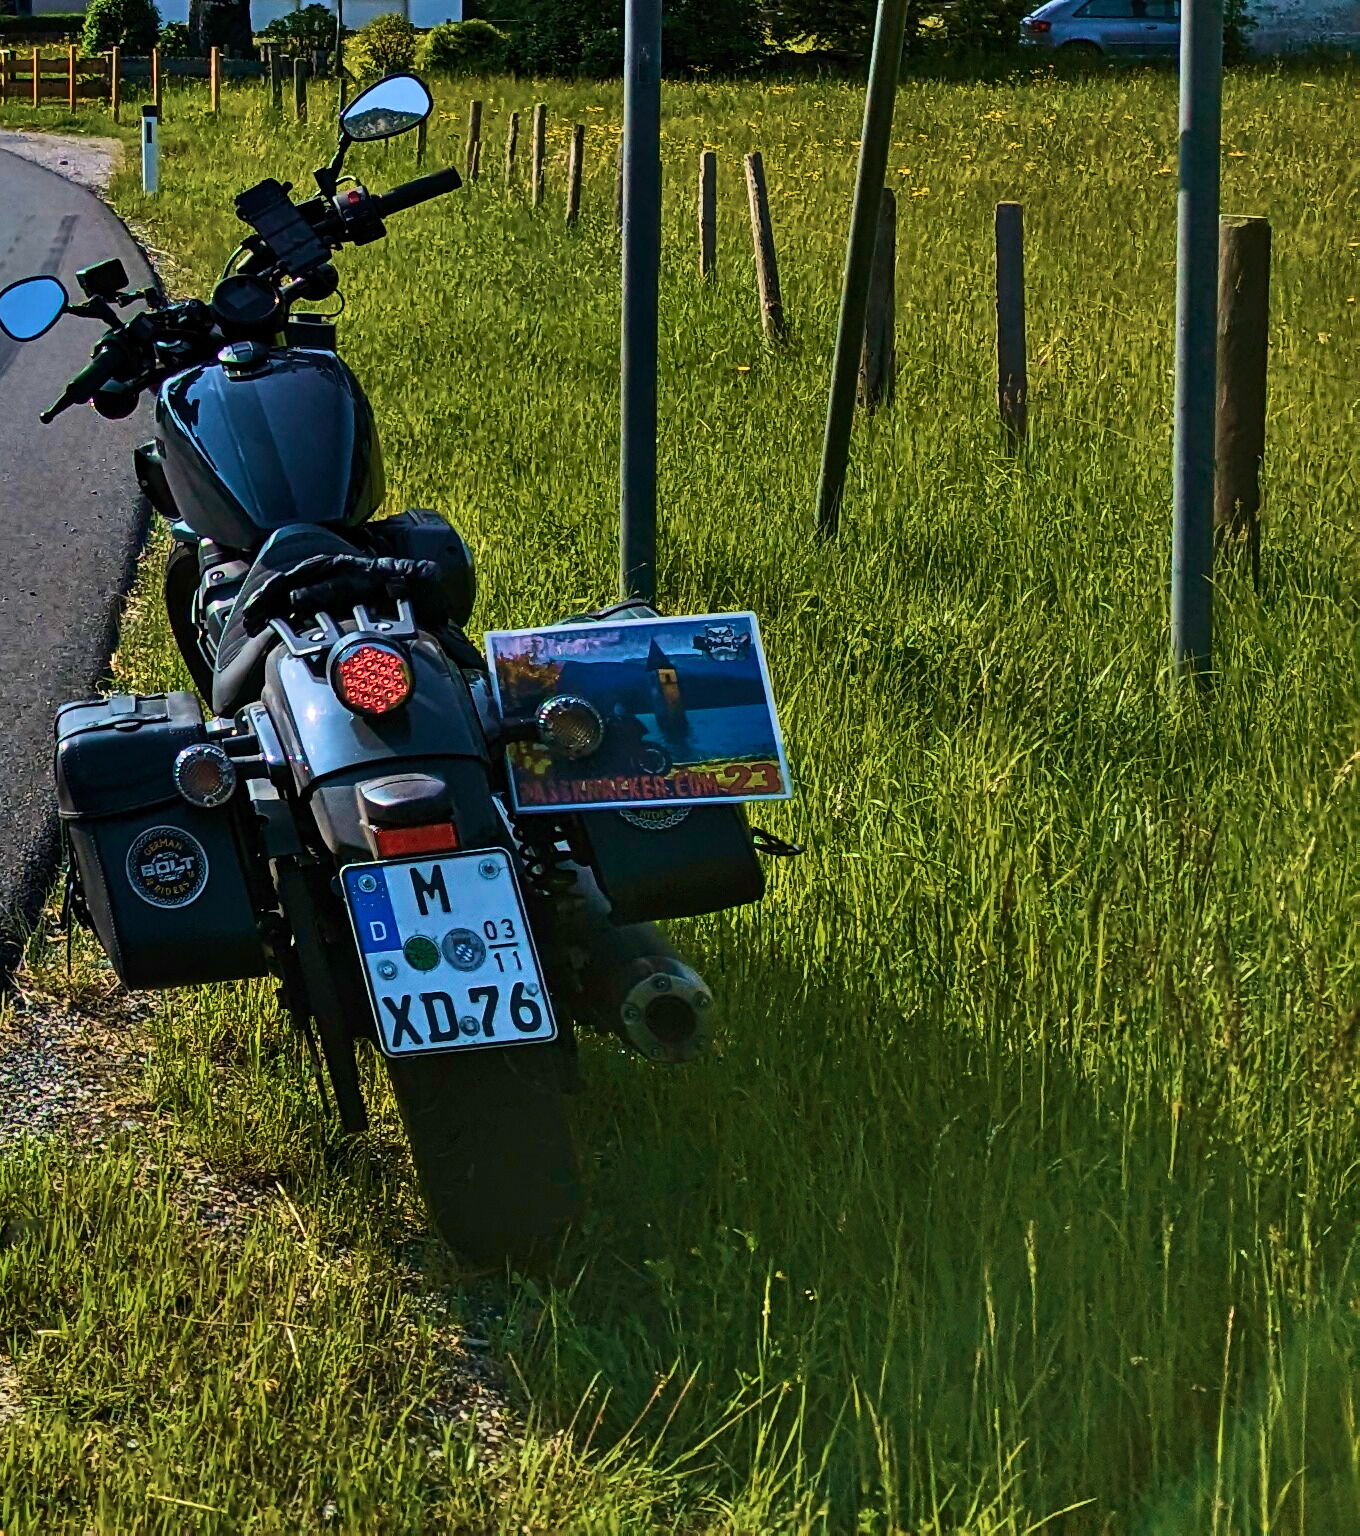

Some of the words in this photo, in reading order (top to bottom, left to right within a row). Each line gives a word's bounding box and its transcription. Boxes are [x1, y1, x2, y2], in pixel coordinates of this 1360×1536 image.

[723, 763, 781, 795] 23
[143, 838, 184, 856] GERMAN
[141, 856, 195, 877] BOLT
[409, 864, 452, 916] M
[369, 920, 387, 942] D
[483, 918, 516, 940] 03
[493, 950, 523, 973] 11
